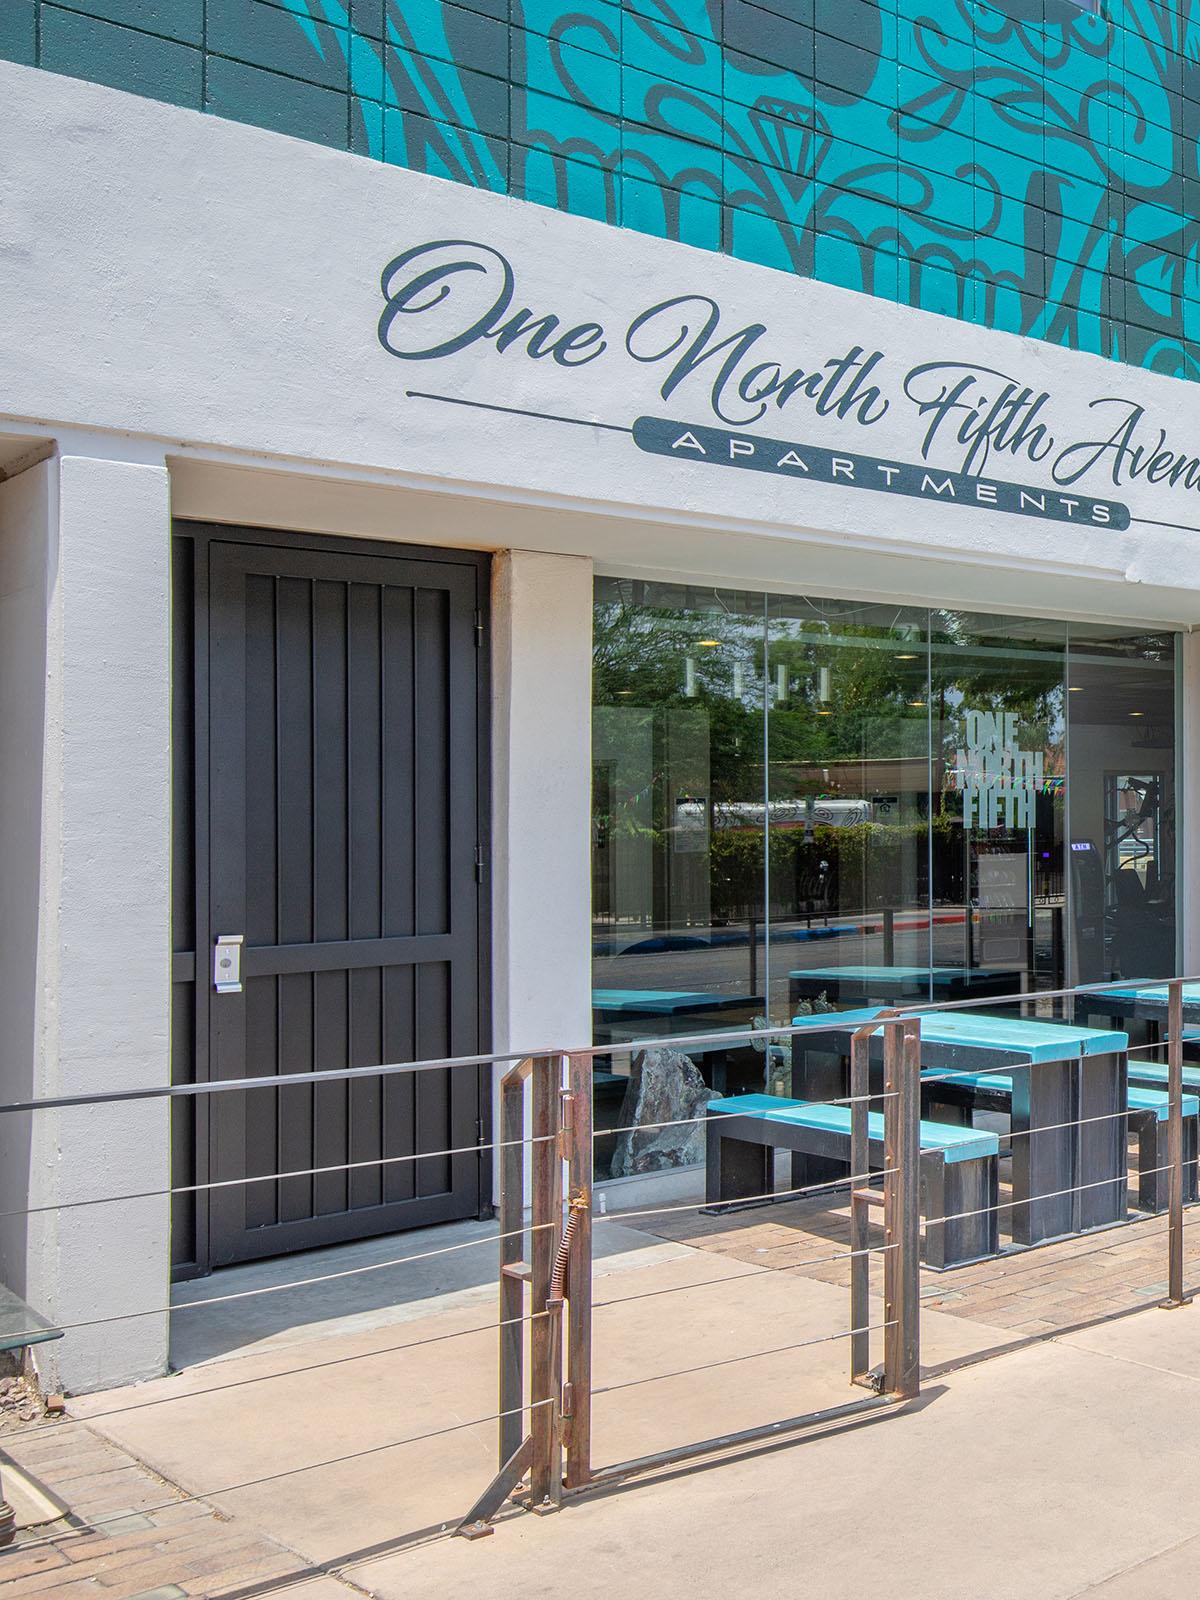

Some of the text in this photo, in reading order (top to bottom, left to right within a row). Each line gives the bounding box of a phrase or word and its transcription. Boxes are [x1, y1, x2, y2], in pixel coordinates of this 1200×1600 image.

[378, 239, 607, 367] One
[625, 294, 889, 426] North
[903, 361, 1054, 477] Fifth
[671, 431, 1110, 523] APARTMENTS
[966, 709, 1018, 751] ONE
[956, 748, 1044, 790] NORTH
[963, 786, 1037, 829] FIFTH
